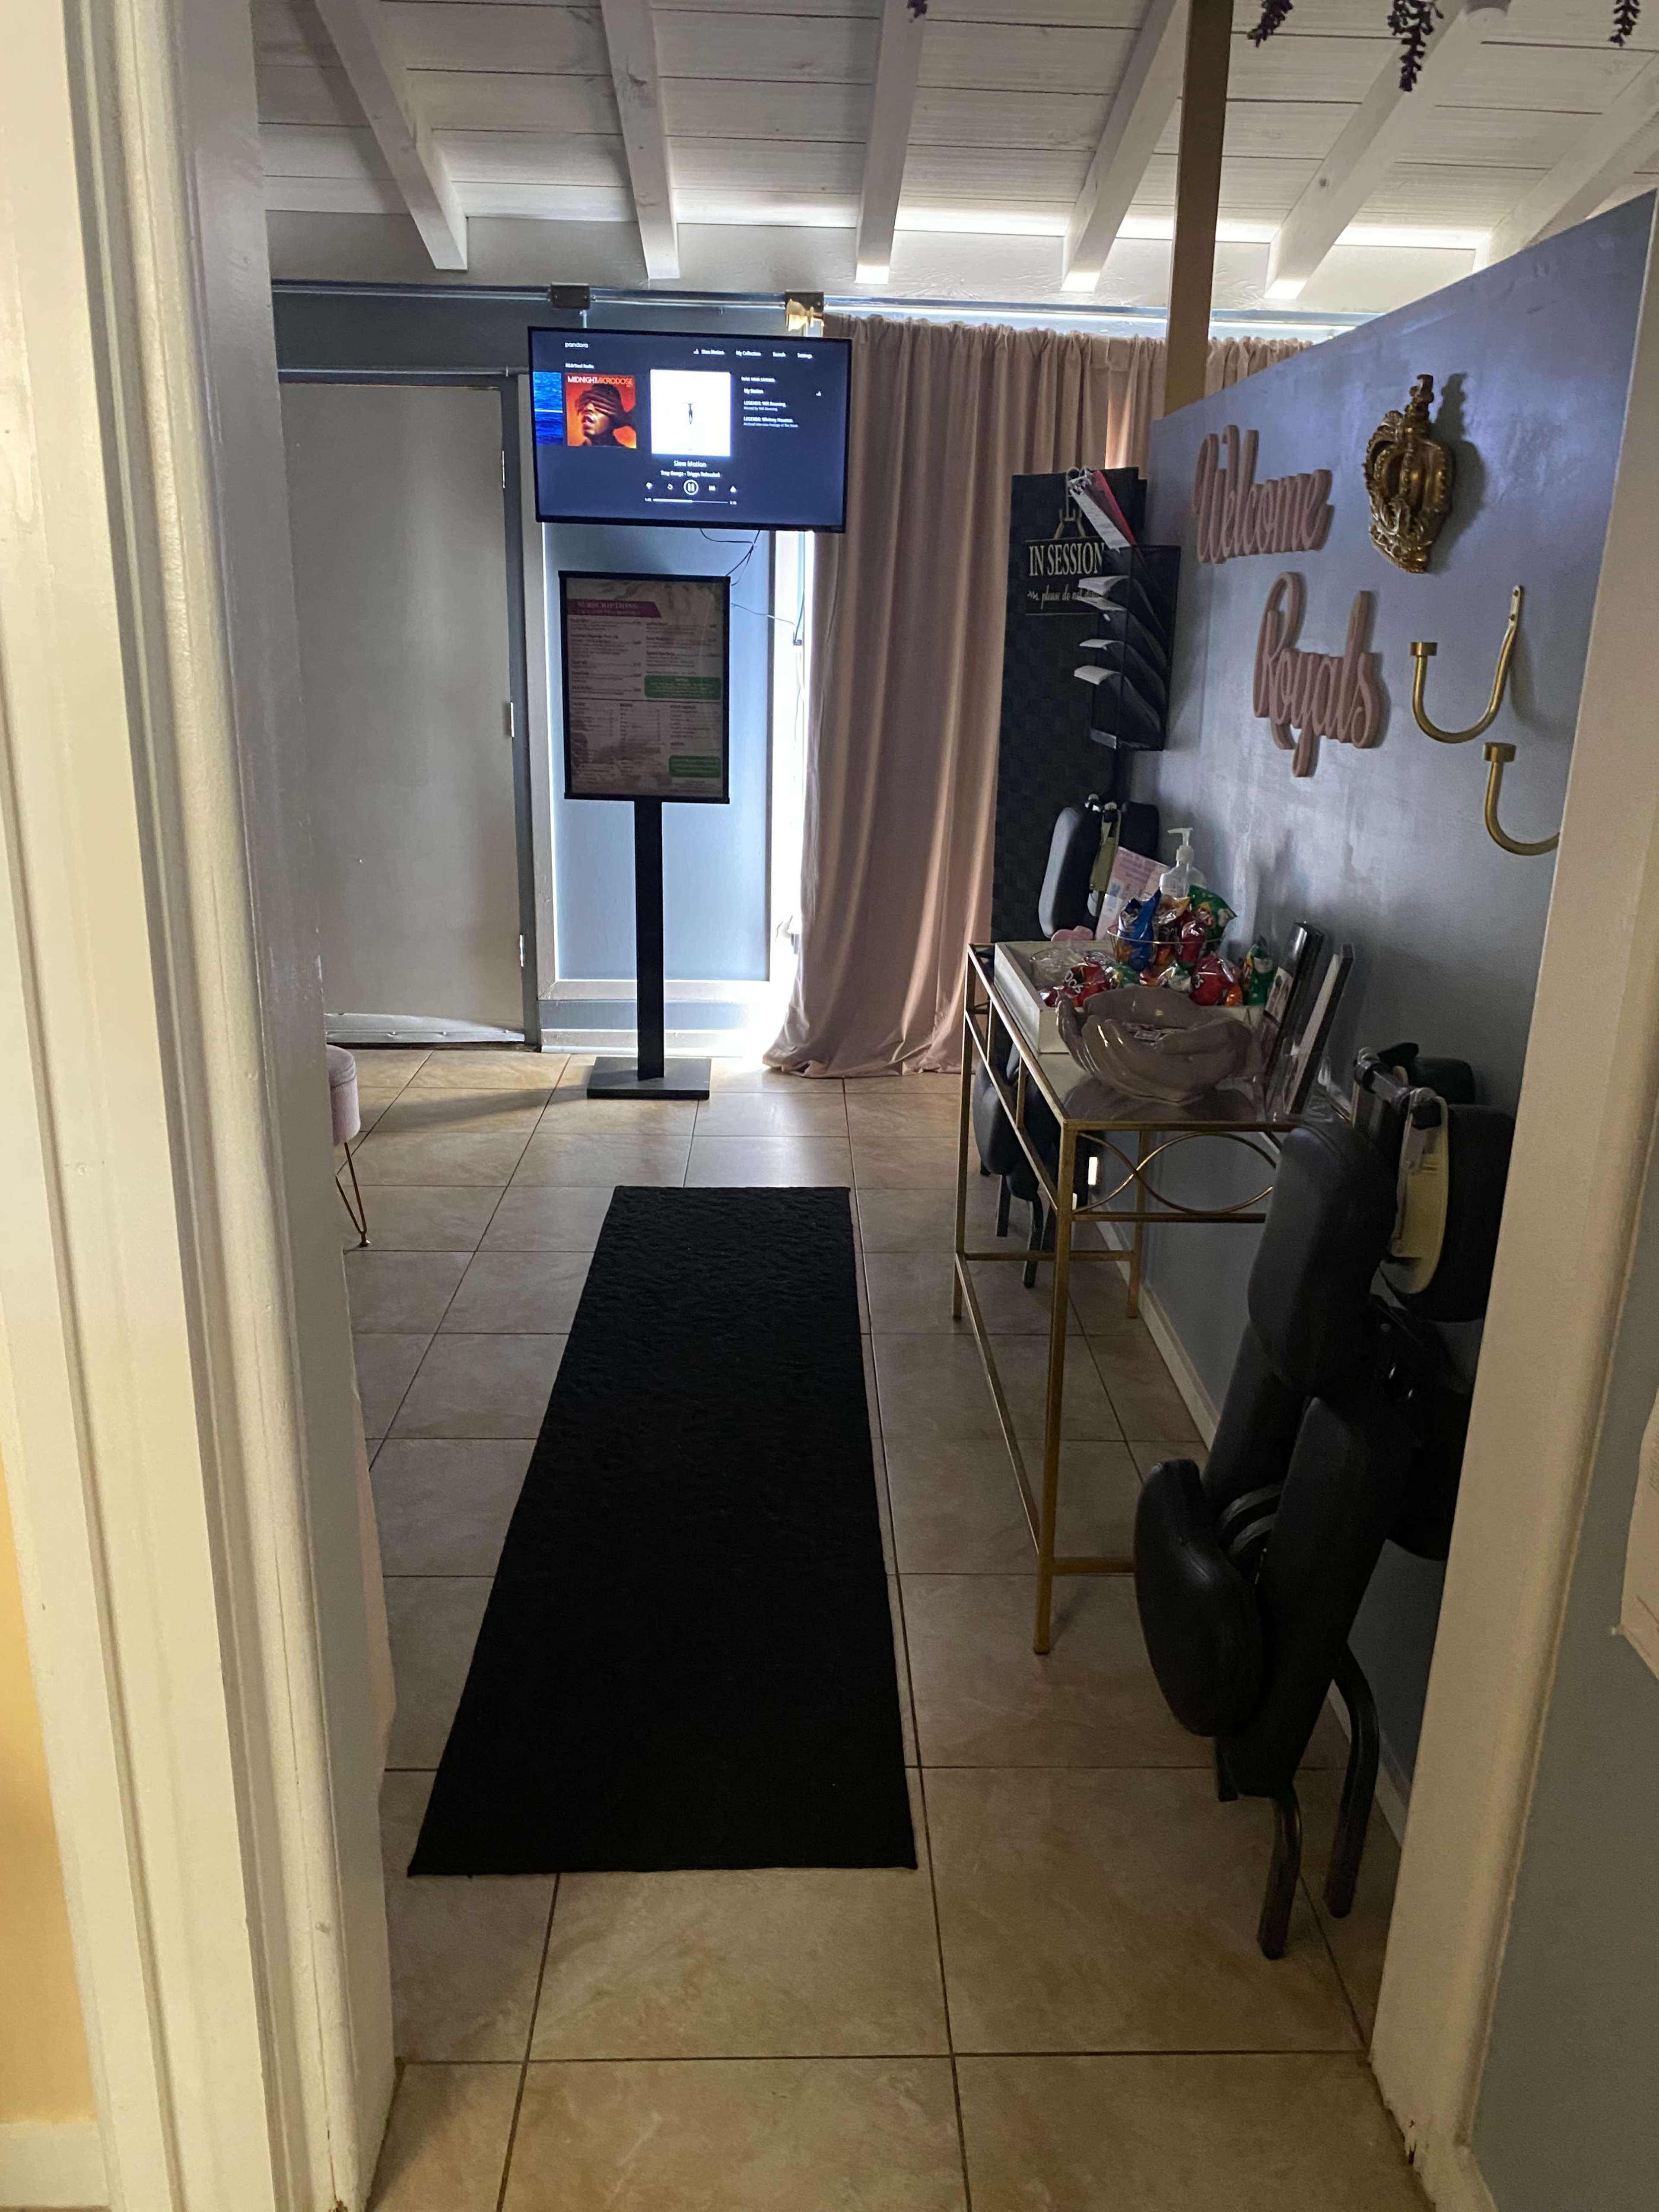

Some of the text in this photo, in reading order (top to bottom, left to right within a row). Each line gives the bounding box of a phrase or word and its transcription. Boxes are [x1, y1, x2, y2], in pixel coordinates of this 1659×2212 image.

[1192, 424, 1334, 564] Welcome
[1029, 542, 1104, 576] IN SESSION
[1062, 584, 1071, 601] do
[1252, 571, 1381, 778] Royals
